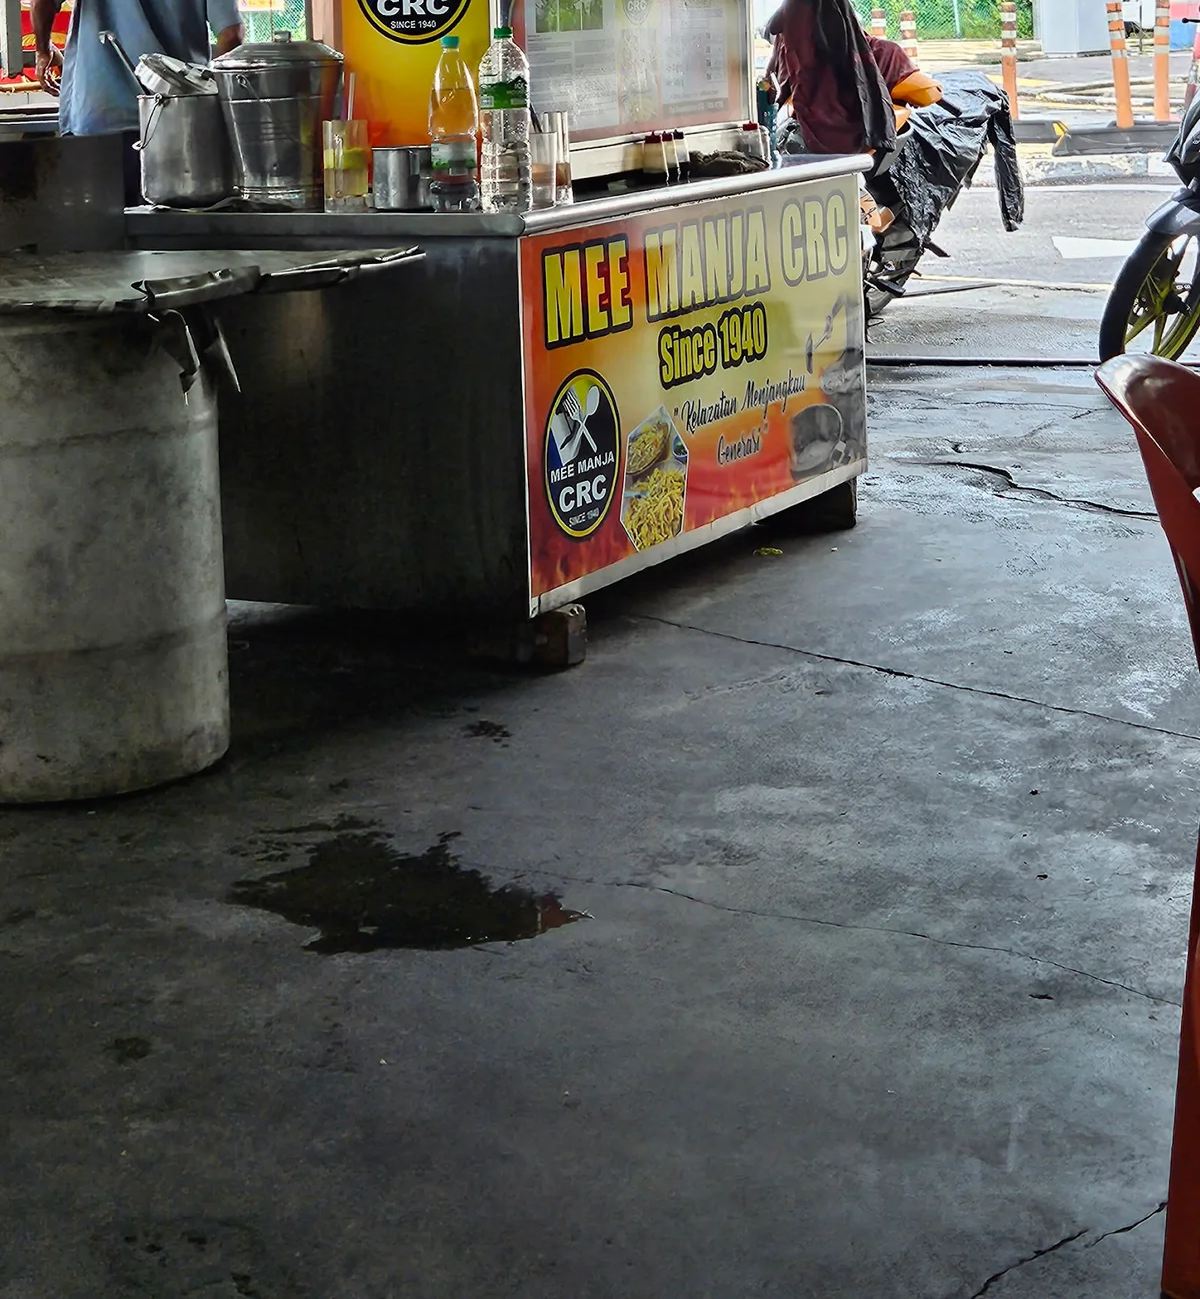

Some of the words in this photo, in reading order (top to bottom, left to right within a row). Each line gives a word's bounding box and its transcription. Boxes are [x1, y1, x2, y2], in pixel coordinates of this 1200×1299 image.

[390, 21, 416, 29] SINCE
[419, 20, 437, 28] 1940
[543, 236, 632, 346] MEE
[645, 208, 770, 320] MANJA
[781, 192, 848, 284] CRC
[659, 324, 718, 388] Since
[718, 303, 767, 367] 1940
[741, 369, 805, 419] Menjangkau
[550, 464, 575, 483] MEE
[578, 451, 615, 474] MANJA
[559, 475, 607, 513] CRC
